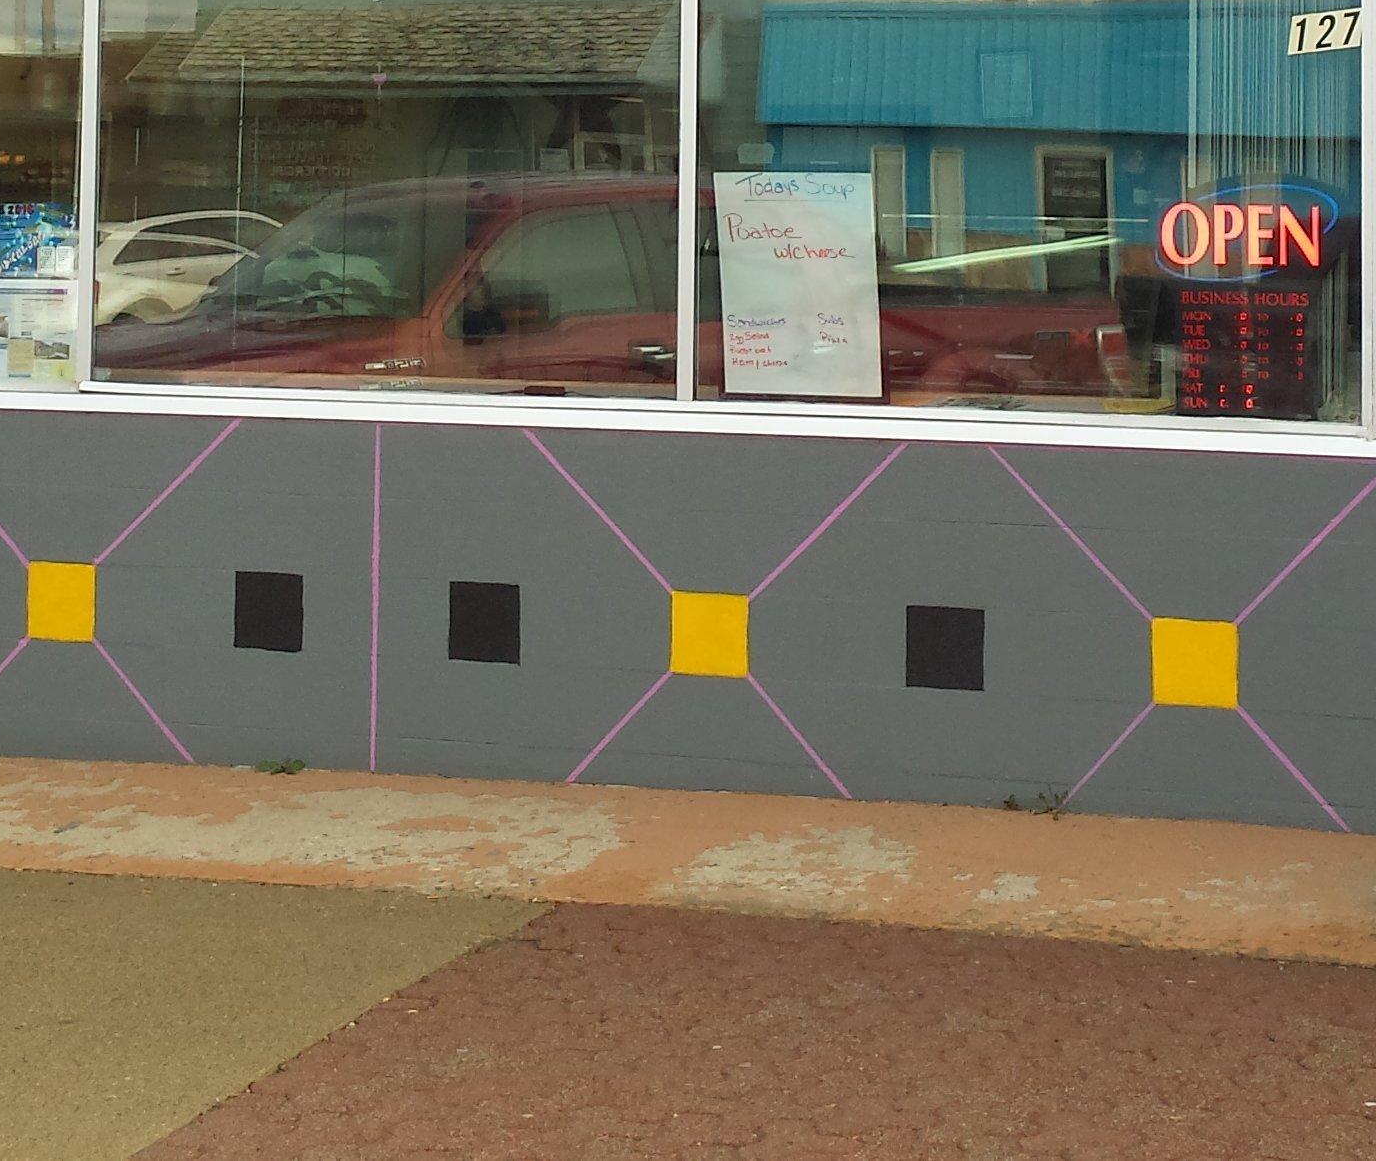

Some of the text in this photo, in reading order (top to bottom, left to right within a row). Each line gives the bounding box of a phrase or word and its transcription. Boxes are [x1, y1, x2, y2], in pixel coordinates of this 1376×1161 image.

[1295, 11, 1359, 52] 127
[735, 173, 855, 199] Todays Soup
[1160, 200, 1321, 268] OPEN
[1181, 291, 1309, 307] BUSINESS HOURS
[1182, 311, 1211, 321] MON
[1183, 325, 1205, 336] TUE
[1182, 339, 1211, 350] WED
[1182, 382, 1203, 394] SAT
[1183, 397, 1208, 408] SUN
